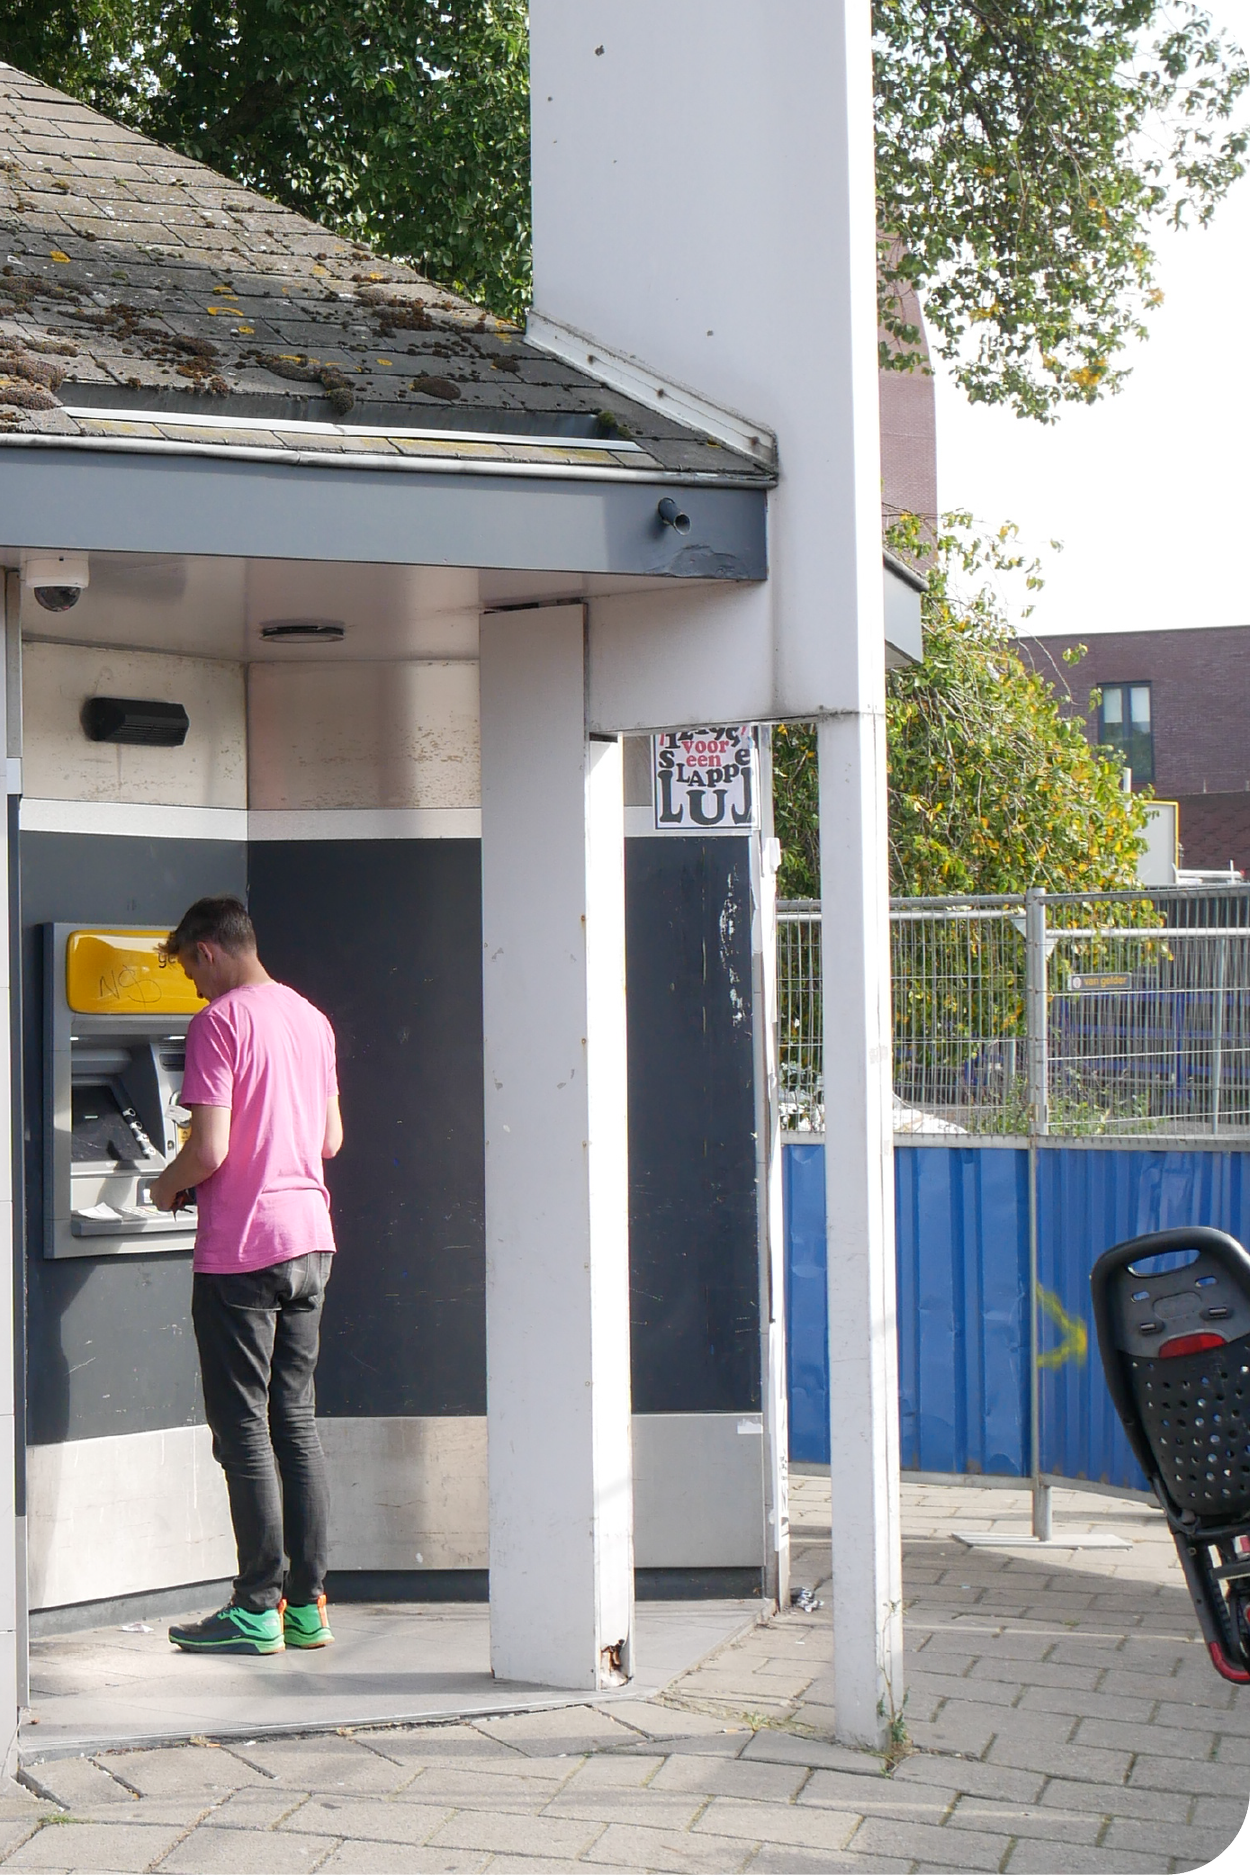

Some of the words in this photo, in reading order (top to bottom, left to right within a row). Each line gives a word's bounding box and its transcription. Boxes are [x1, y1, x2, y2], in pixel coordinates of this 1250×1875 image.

[681, 740, 730, 754] voor
[686, 755, 722, 767] een
[1083, 977, 1099, 986] van
[1101, 975, 1127, 988] gelder
